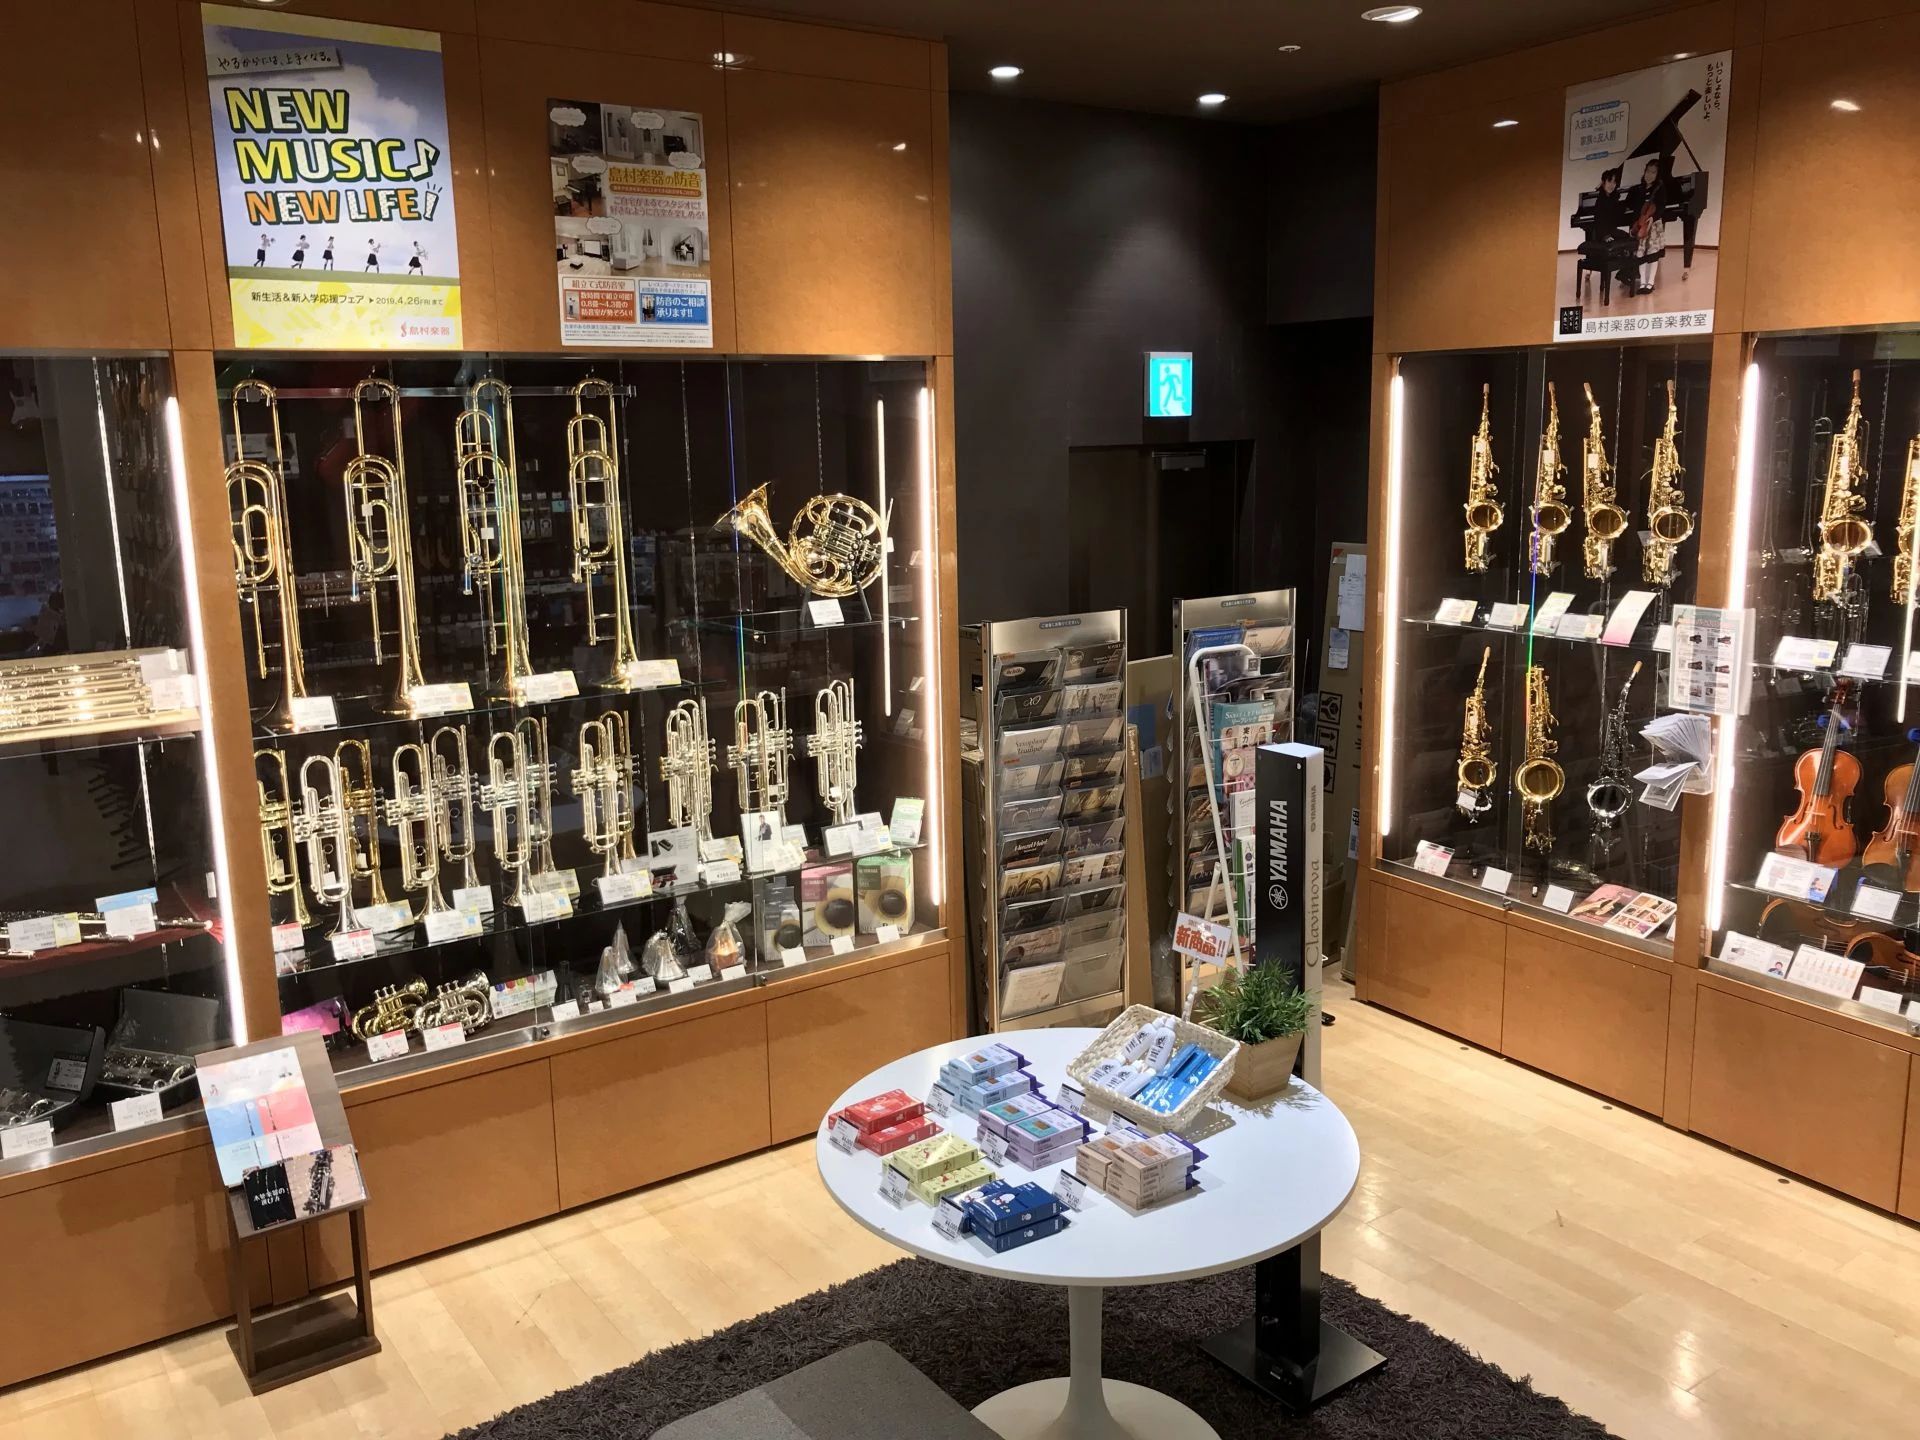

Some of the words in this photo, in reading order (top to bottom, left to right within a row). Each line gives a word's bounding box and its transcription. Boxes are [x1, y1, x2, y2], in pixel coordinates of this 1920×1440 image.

[224, 88, 349, 133] NEW
[233, 138, 409, 183] MUSIC
[608, 167, 700, 187] 島村楽器の防音
[245, 190, 340, 225] NEW
[656, 296, 705, 308] 防音のご相談
[1585, 313, 1708, 334] 島村楽器の音楽教室
[1269, 800, 1288, 882] YAMAHA
[1306, 860, 1319, 967] Clavinova
[1176, 925, 1224, 958] 新商品!!
